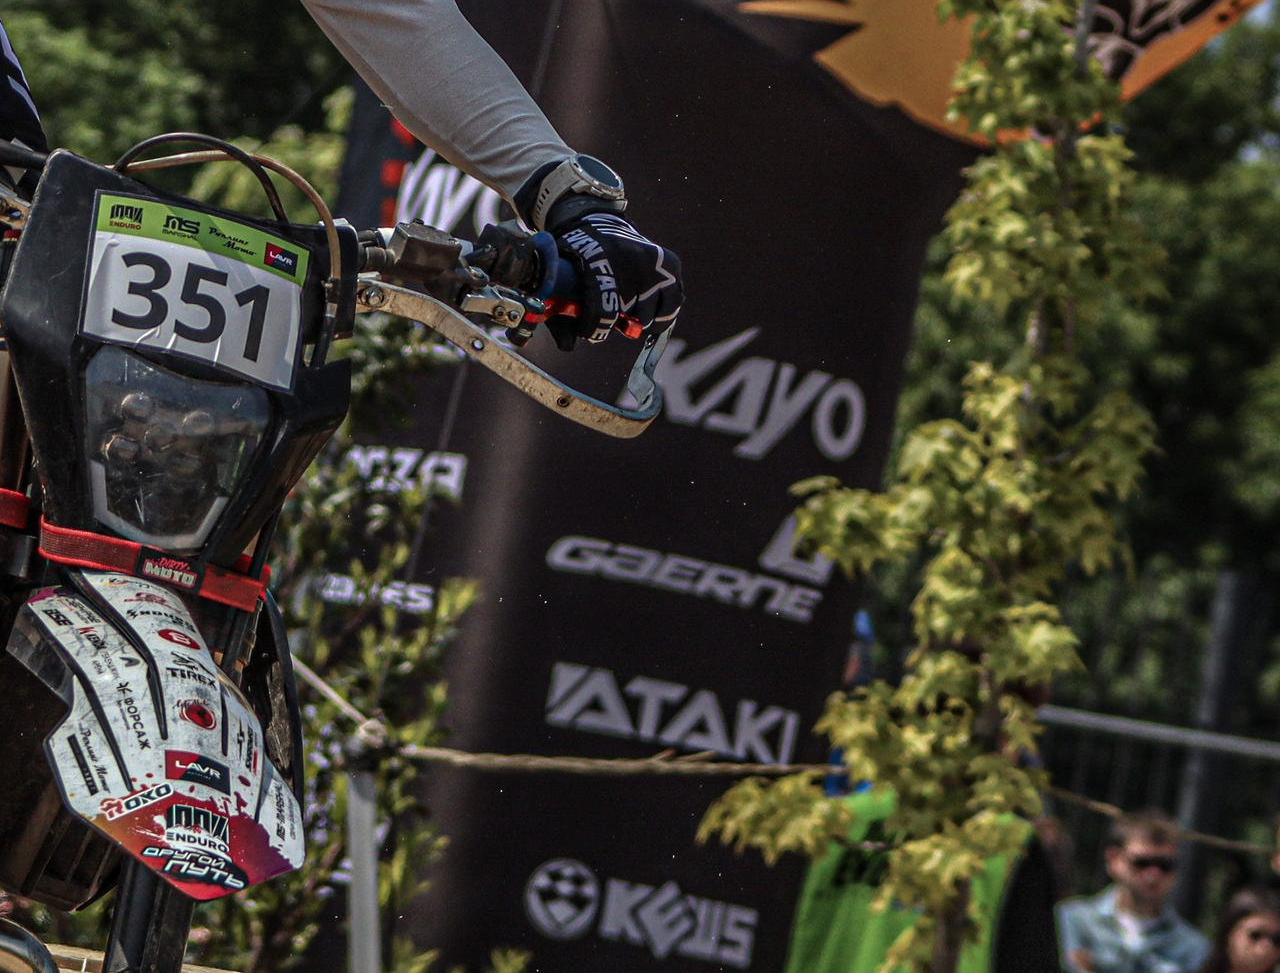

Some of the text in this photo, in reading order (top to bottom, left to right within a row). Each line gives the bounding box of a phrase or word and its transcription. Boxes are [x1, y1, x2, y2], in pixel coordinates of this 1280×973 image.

[109, 220, 142, 231] ENDURO
[162, 229, 199, 241] MARSHAL
[562, 228, 604, 260] EVEN
[269, 250, 293, 266] LAVR
[111, 252, 271, 363] 351
[617, 326, 867, 461] KAYO
[144, 561, 195, 586] MOTO
[159, 557, 188, 571] DIRTY
[545, 535, 822, 623] GAERNE
[42, 608, 74, 626] BSE
[166, 667, 218, 691] TIREX
[124, 697, 152, 751] ФОРСАЖ
[545, 661, 801, 766] ATAKI
[175, 760, 221, 779] LAVR
[100, 783, 172, 820] ROKO
[166, 831, 228, 853] ENDURO
[142, 846, 228, 869] ДРУГОЙ
[164, 859, 246, 890] ПУТЬ
